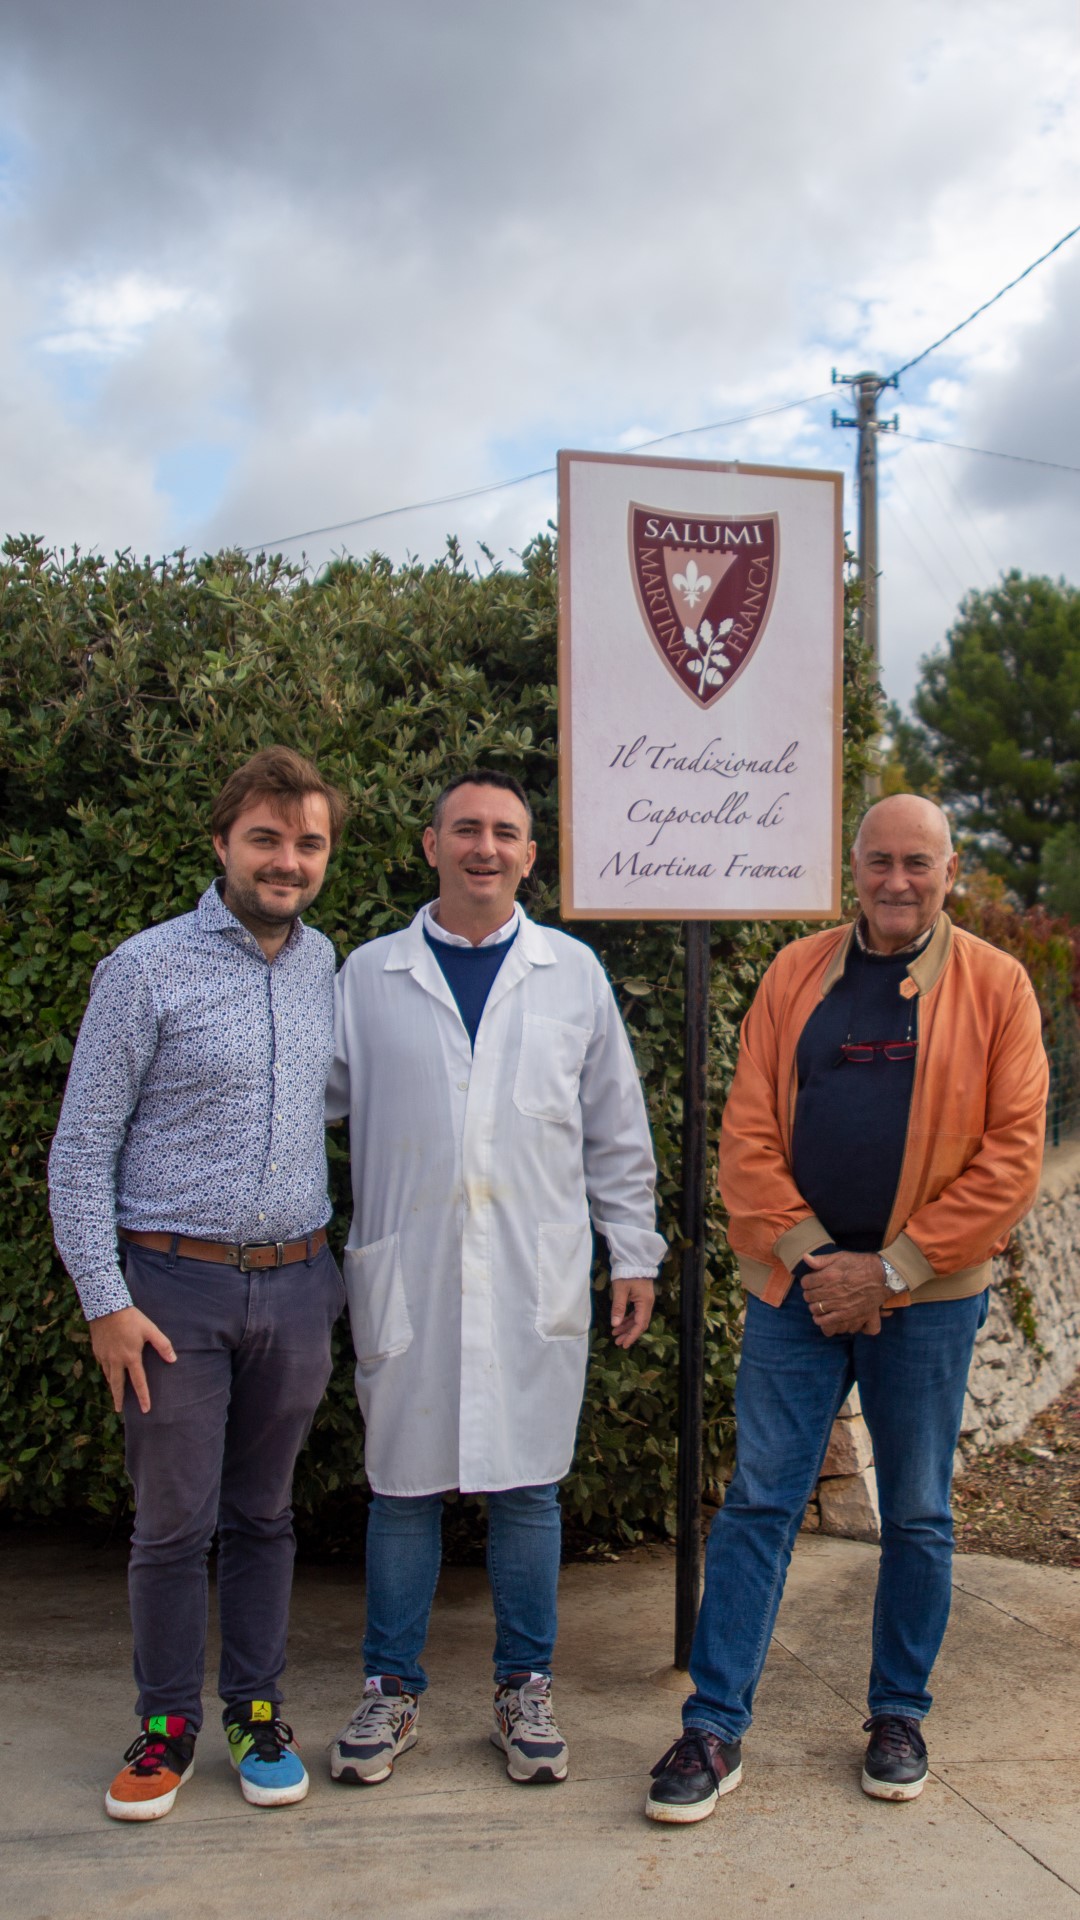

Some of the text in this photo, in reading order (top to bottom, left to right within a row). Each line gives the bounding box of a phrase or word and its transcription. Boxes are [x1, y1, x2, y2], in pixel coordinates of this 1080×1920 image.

[644, 518, 764, 545] SALUMI
[638, 547, 689, 667] MARTINA
[726, 554, 770, 653] FRANCA
[608, 735, 800, 779] Il Tradizionale
[627, 791, 790, 847] Capocollo di
[599, 851, 807, 888] Martina Franca
